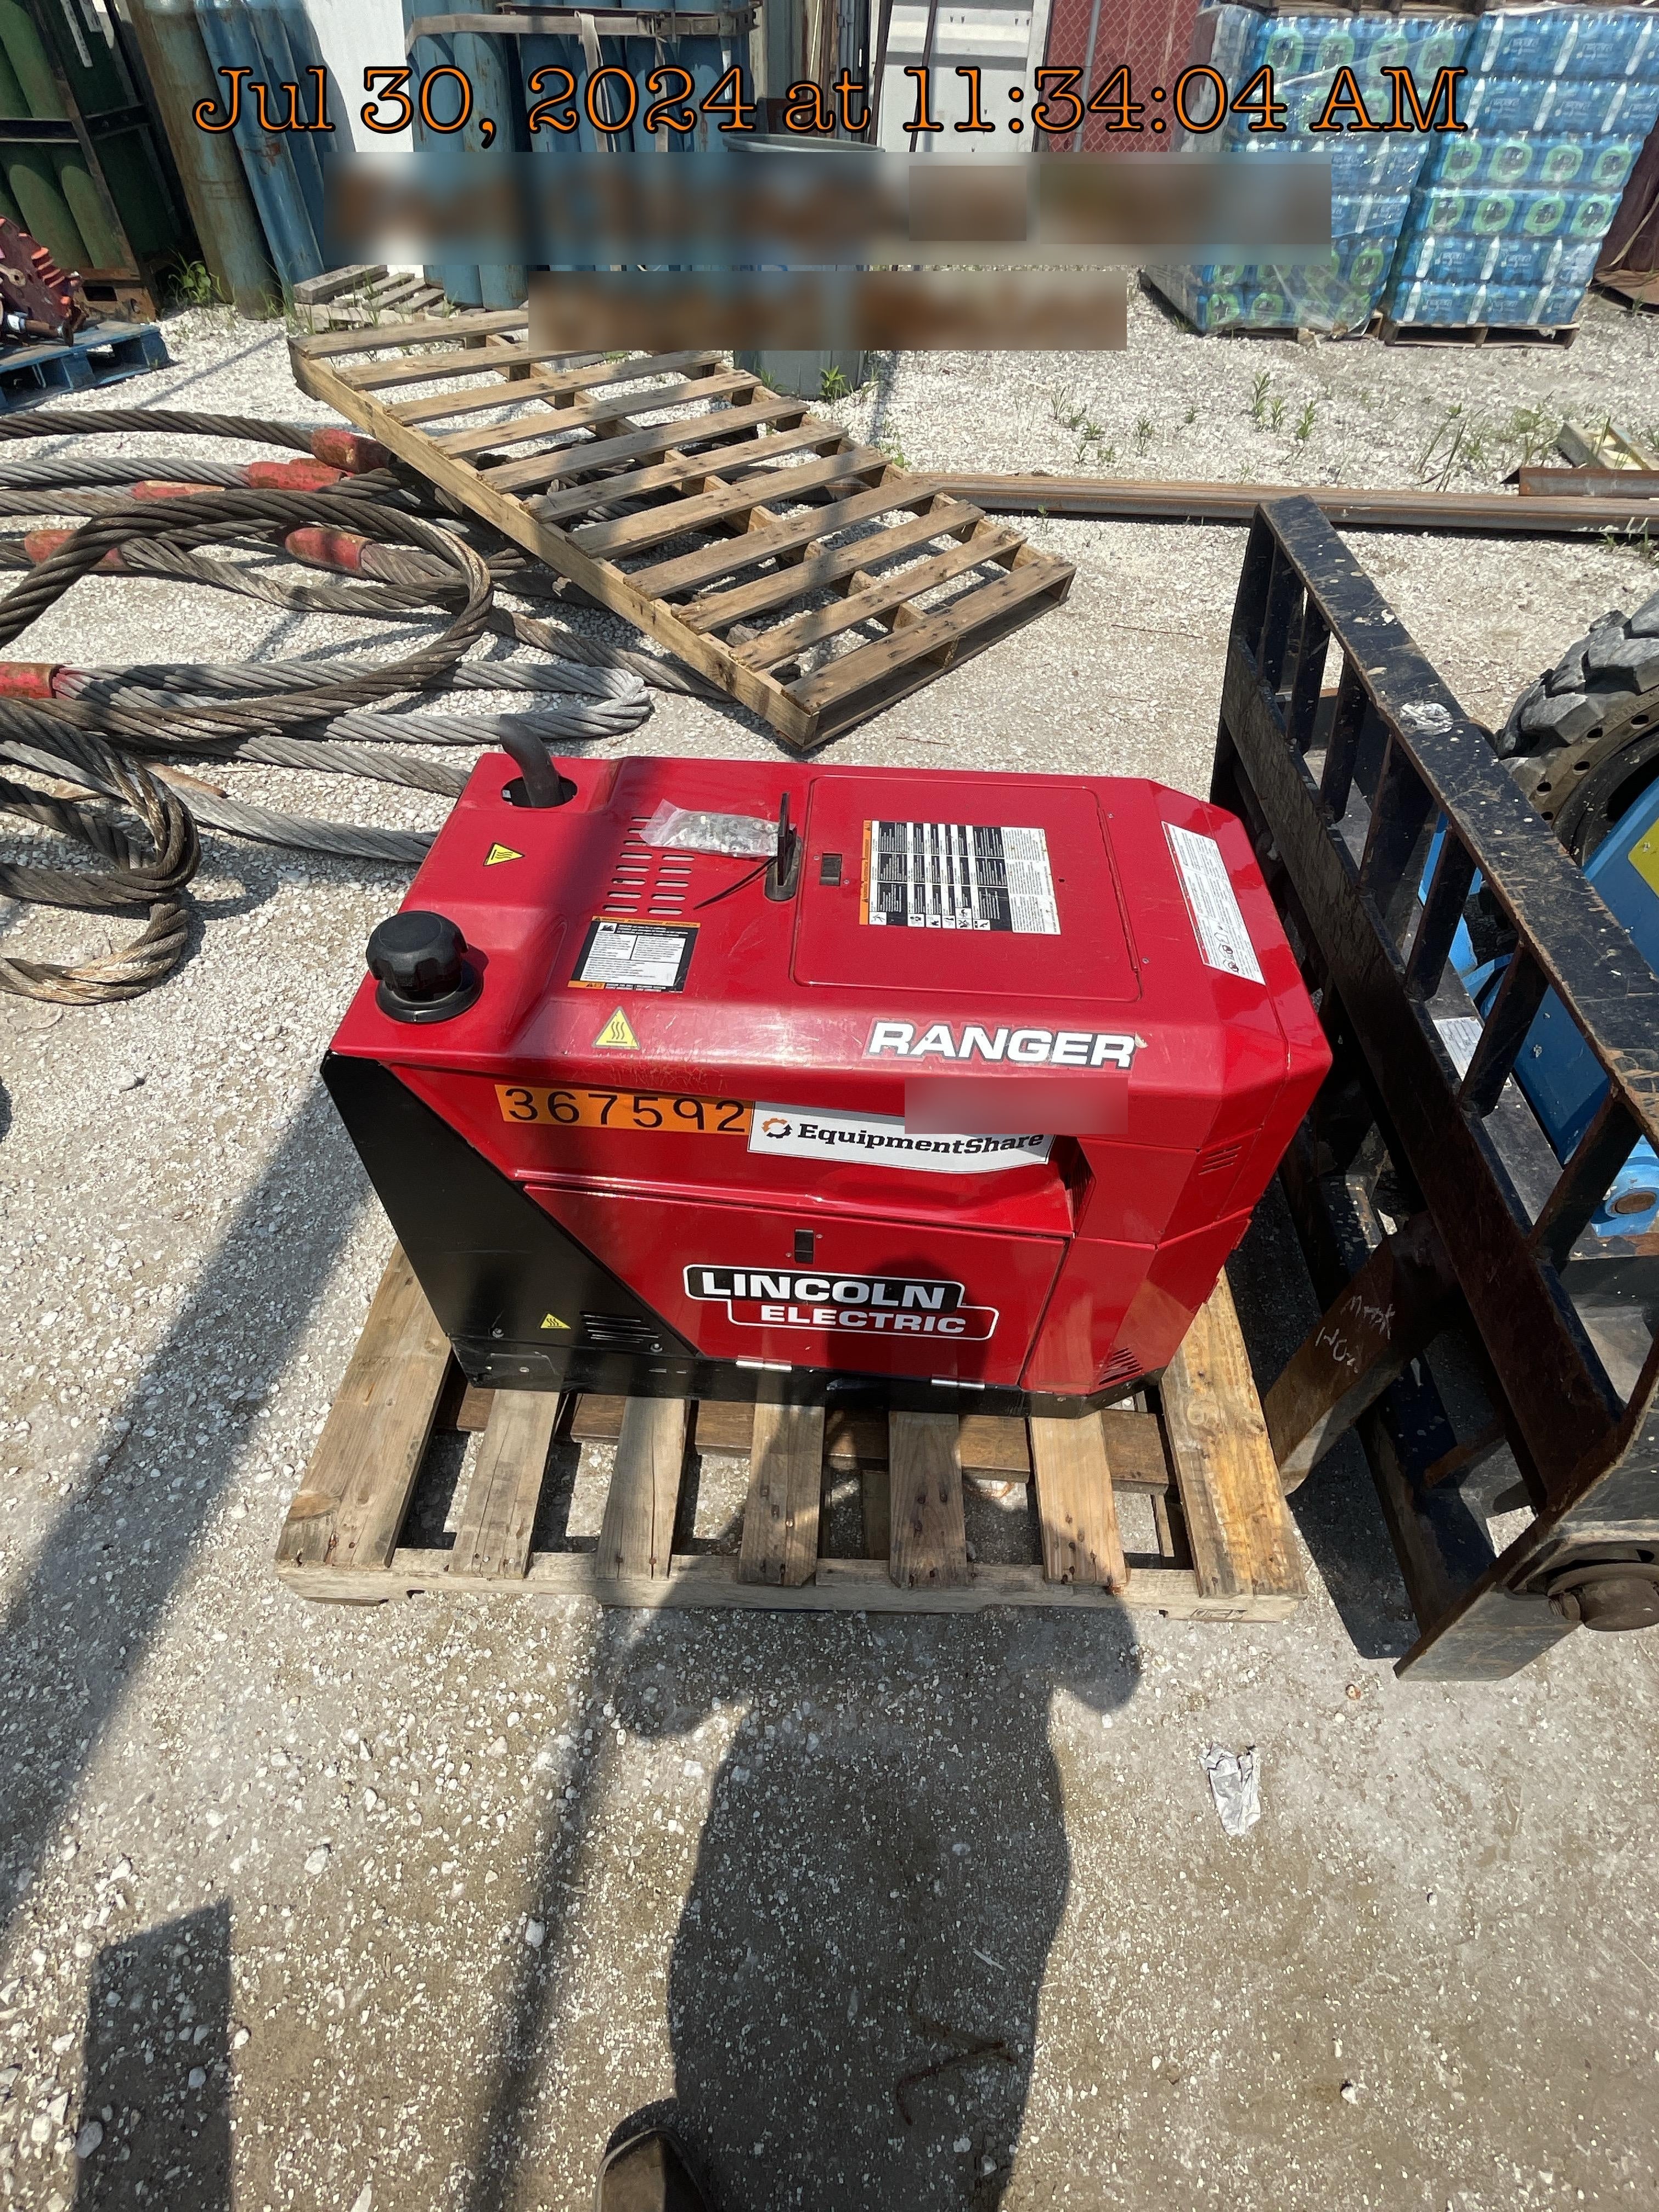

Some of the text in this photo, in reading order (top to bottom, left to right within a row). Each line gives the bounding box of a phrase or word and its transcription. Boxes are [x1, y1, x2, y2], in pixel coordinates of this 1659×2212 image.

[867, 1021, 1136, 1069] RANGER
[505, 1088, 745, 1132] 367592
[798, 1122, 1043, 1154] EquipmentShare
[701, 1272, 945, 1309] LINCOLN
[760, 1305, 966, 1333] ELECTRIC
